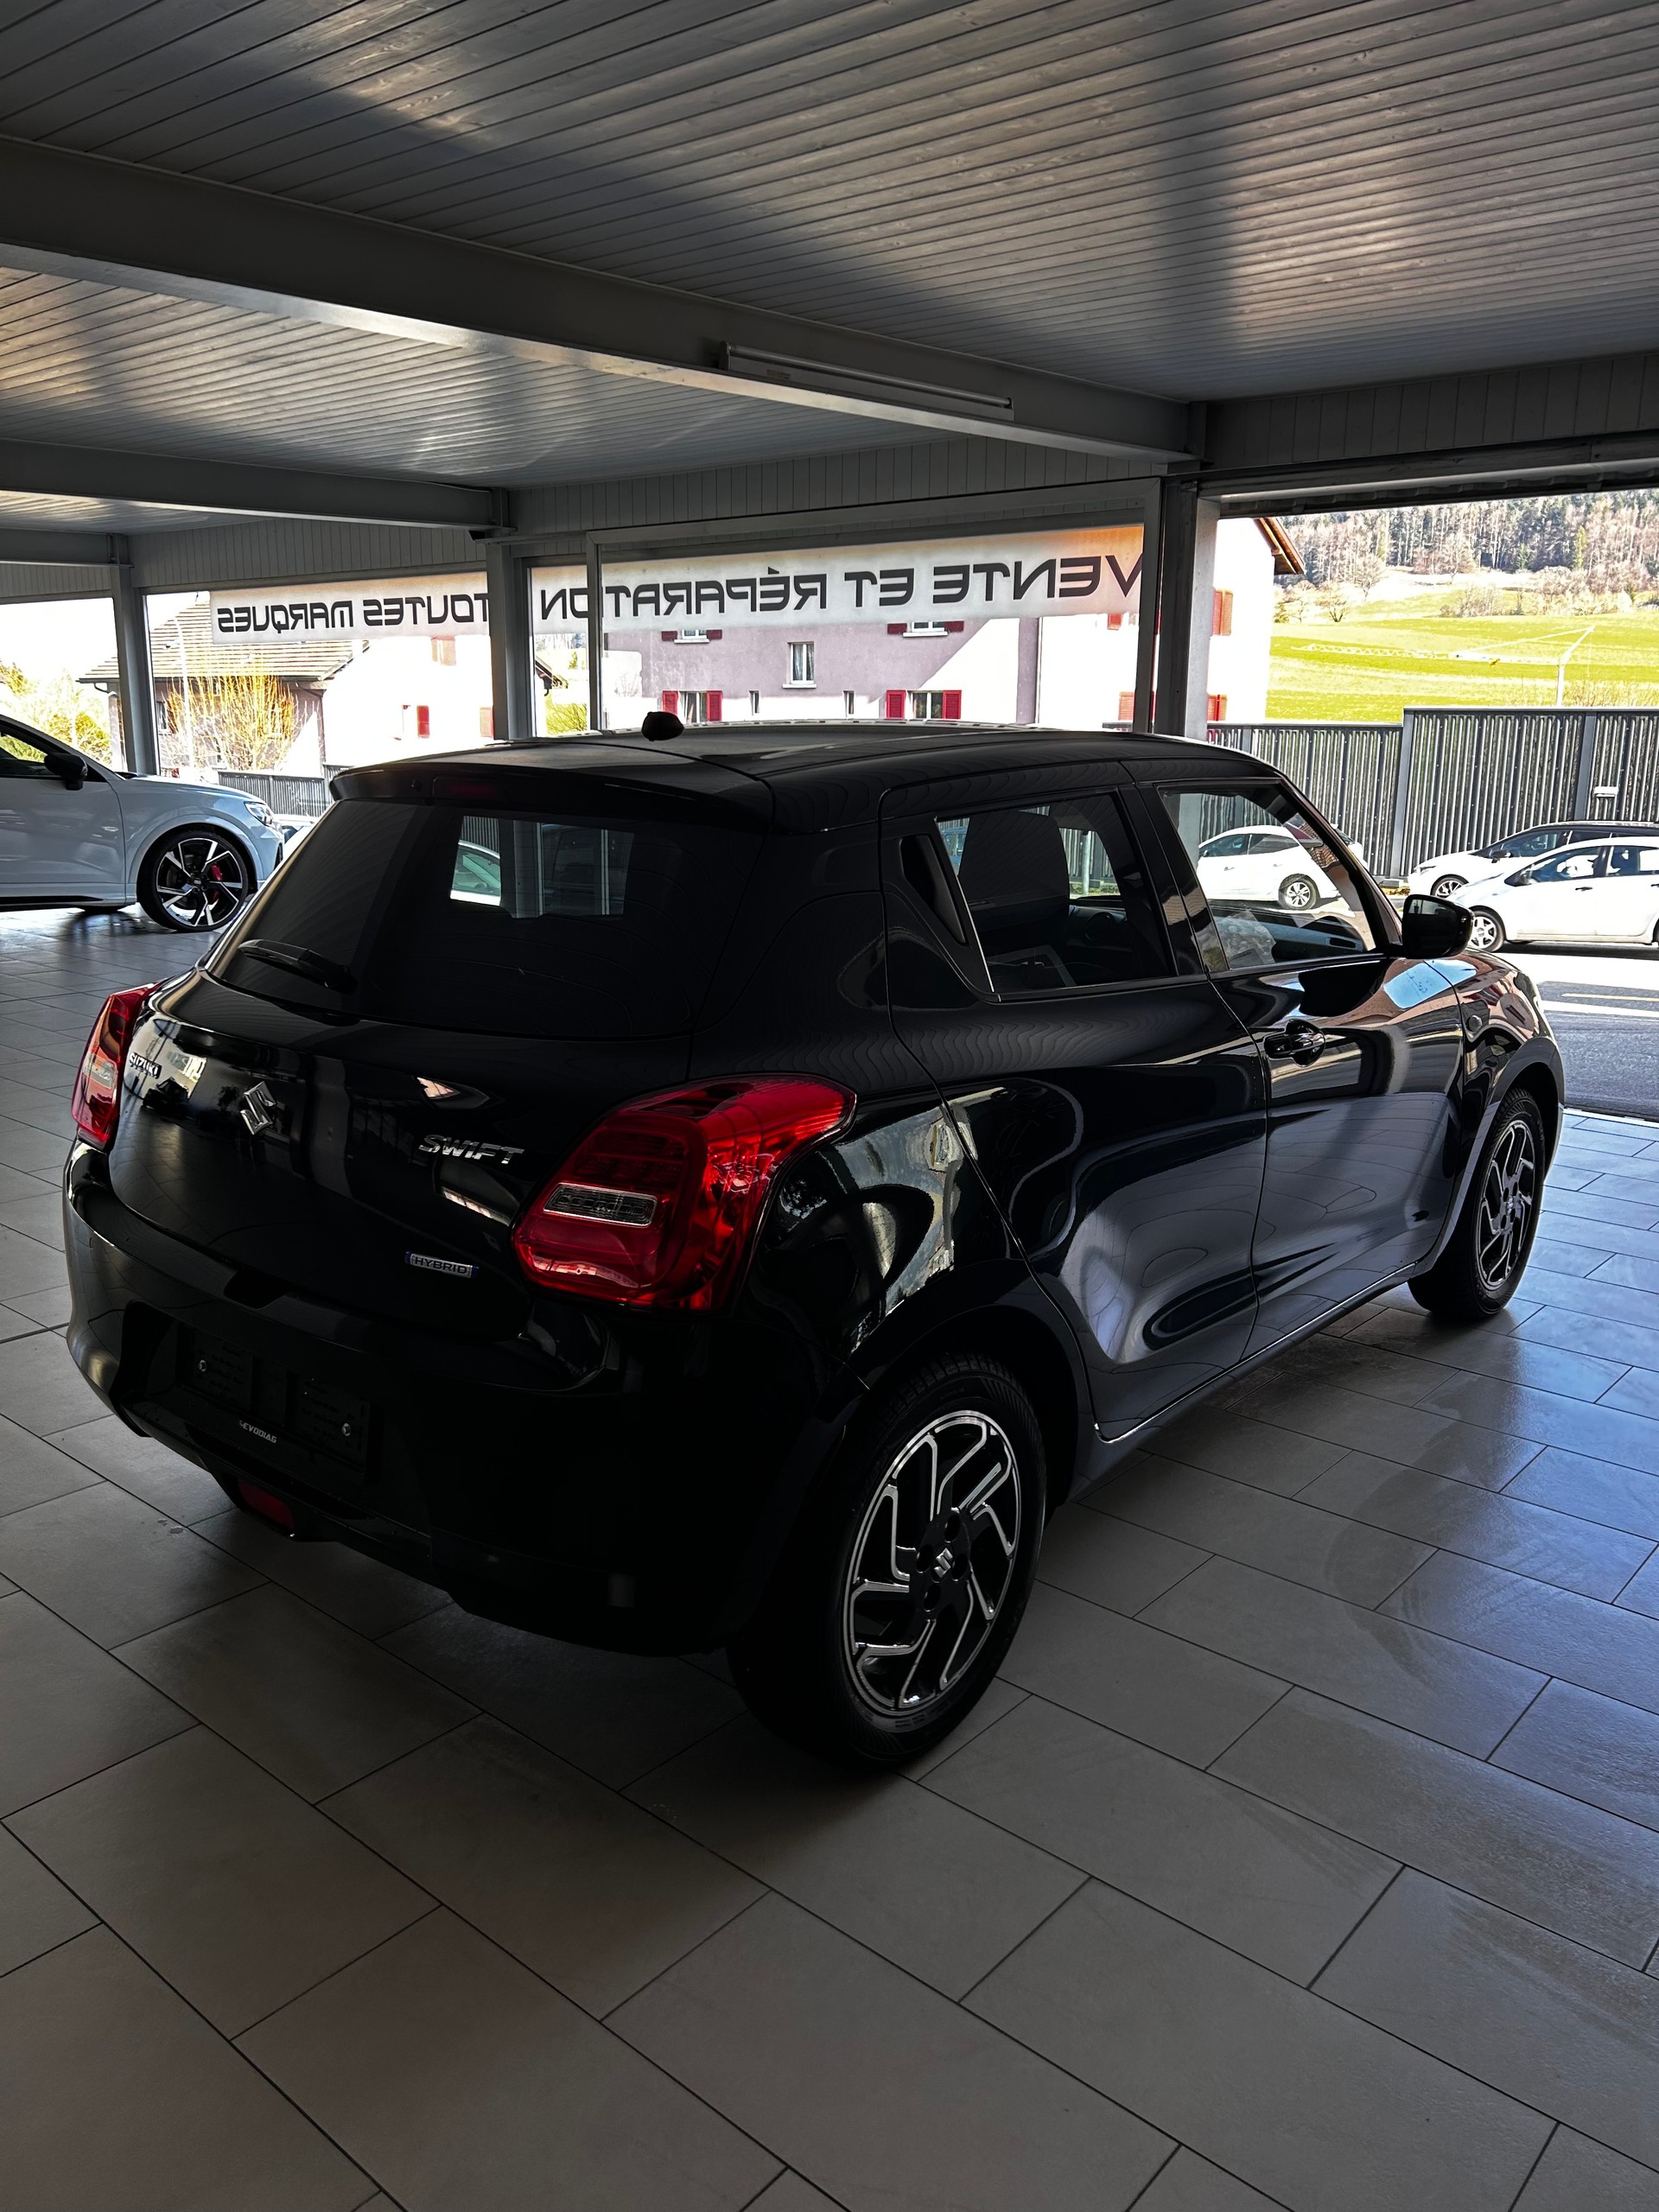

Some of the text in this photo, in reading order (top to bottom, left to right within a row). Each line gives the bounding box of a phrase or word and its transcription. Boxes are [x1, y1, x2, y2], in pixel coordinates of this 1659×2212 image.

[129, 1052, 161, 1078] SUZUKI
[418, 1134, 526, 1165] SWIFT
[414, 1255, 468, 1275] HYBRID
